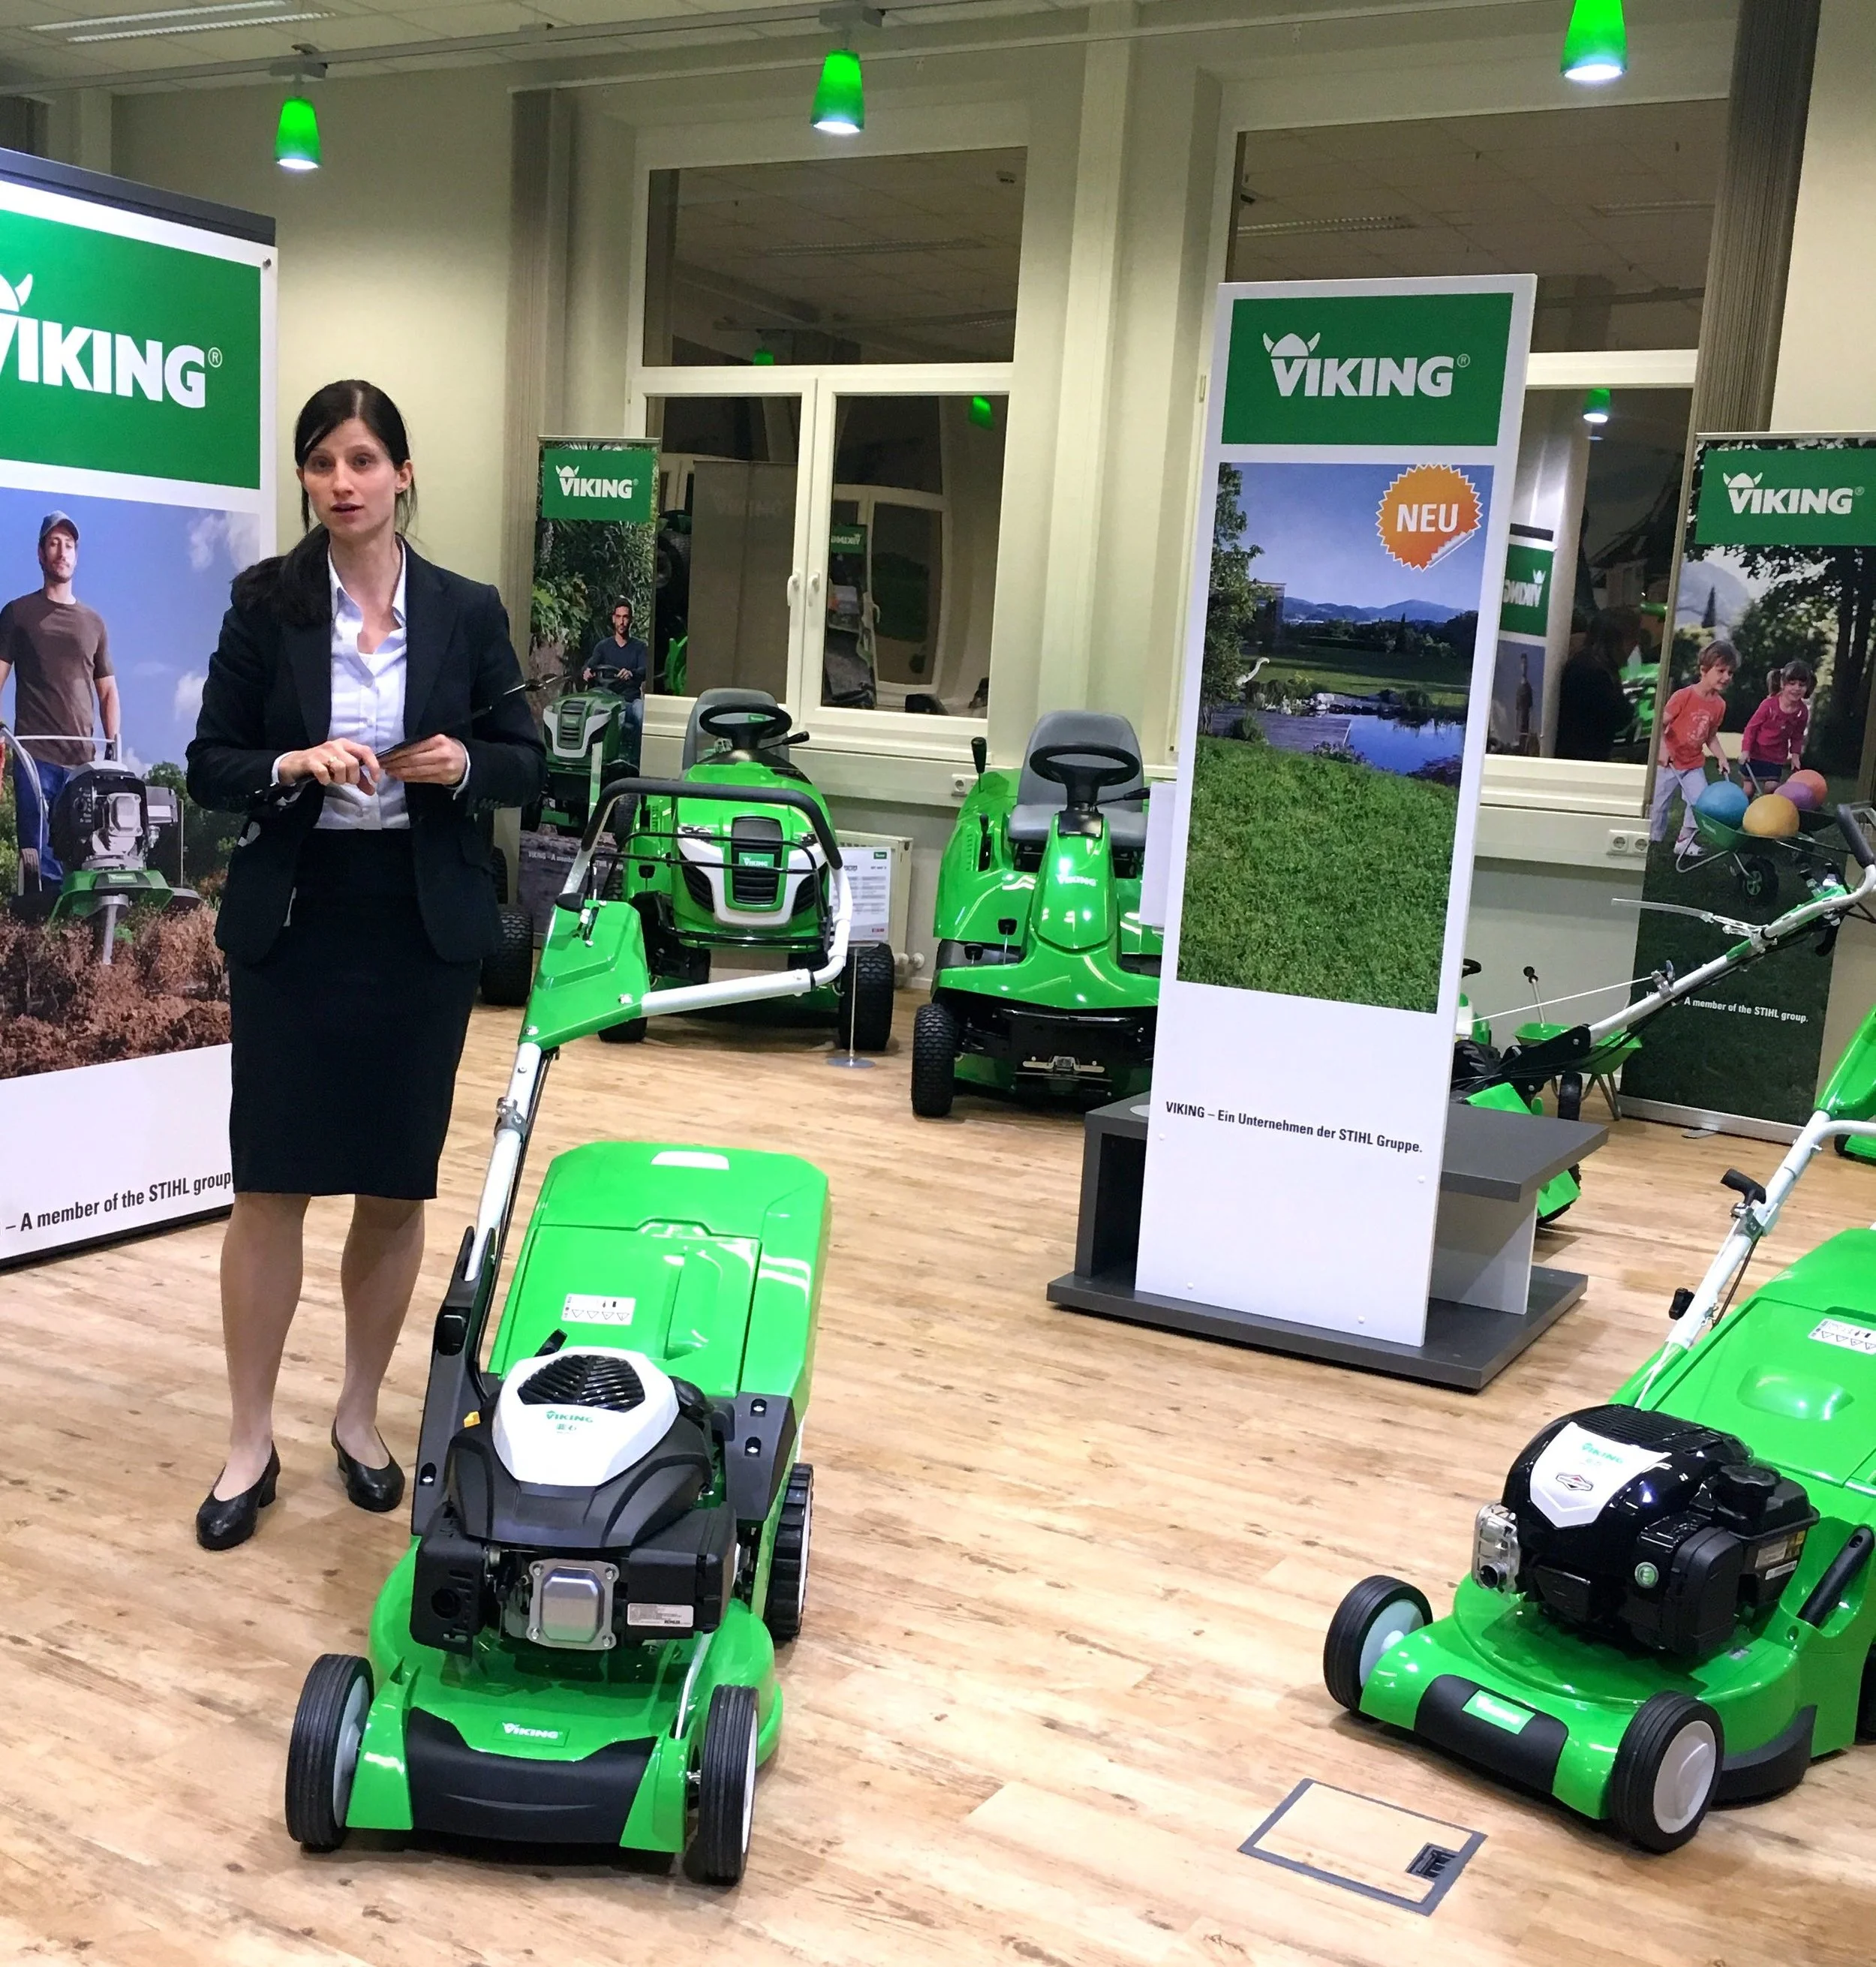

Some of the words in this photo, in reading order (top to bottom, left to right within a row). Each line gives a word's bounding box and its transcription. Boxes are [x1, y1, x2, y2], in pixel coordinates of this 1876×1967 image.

[1396, 504, 1459, 533] NEU
[1684, 997, 1691, 1006] A
[1692, 1000, 1726, 1011] member
[1728, 1003, 1737, 1012] of
[1738, 1006, 1752, 1014] the
[1754, 1006, 1779, 1018] STIHL
[1781, 1012, 1808, 1024] group.
[1165, 1101, 1205, 1118] VIKING
[1218, 1109, 1235, 1123] Ein
[1238, 1113, 1313, 1135] Unternehmen
[1316, 1125, 1336, 1138] der
[1339, 1129, 1374, 1144] STIHL
[1376, 1135, 1423, 1153] Gruppe.
[20, 1213, 33, 1232] A
[37, 1202, 100, 1228] member
[104, 1193, 119, 1213] of
[122, 1190, 145, 1208] the
[149, 1177, 190, 1202] STIHL
